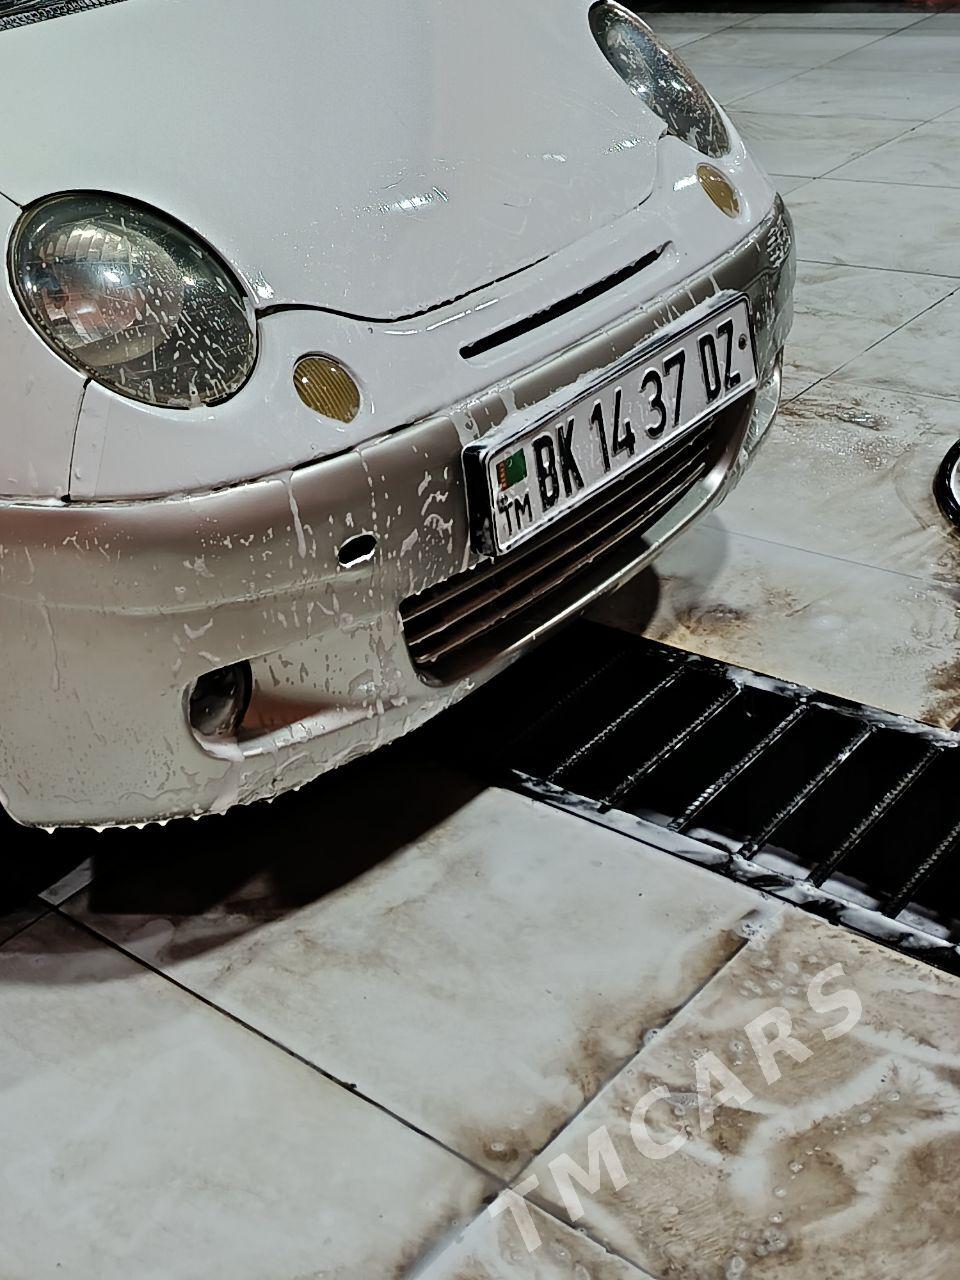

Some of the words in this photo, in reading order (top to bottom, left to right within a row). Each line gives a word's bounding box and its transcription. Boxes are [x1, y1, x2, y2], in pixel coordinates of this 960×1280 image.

[532, 417, 585, 513] BK
[697, 318, 741, 404] DZ
[498, 491, 533, 536] TM
